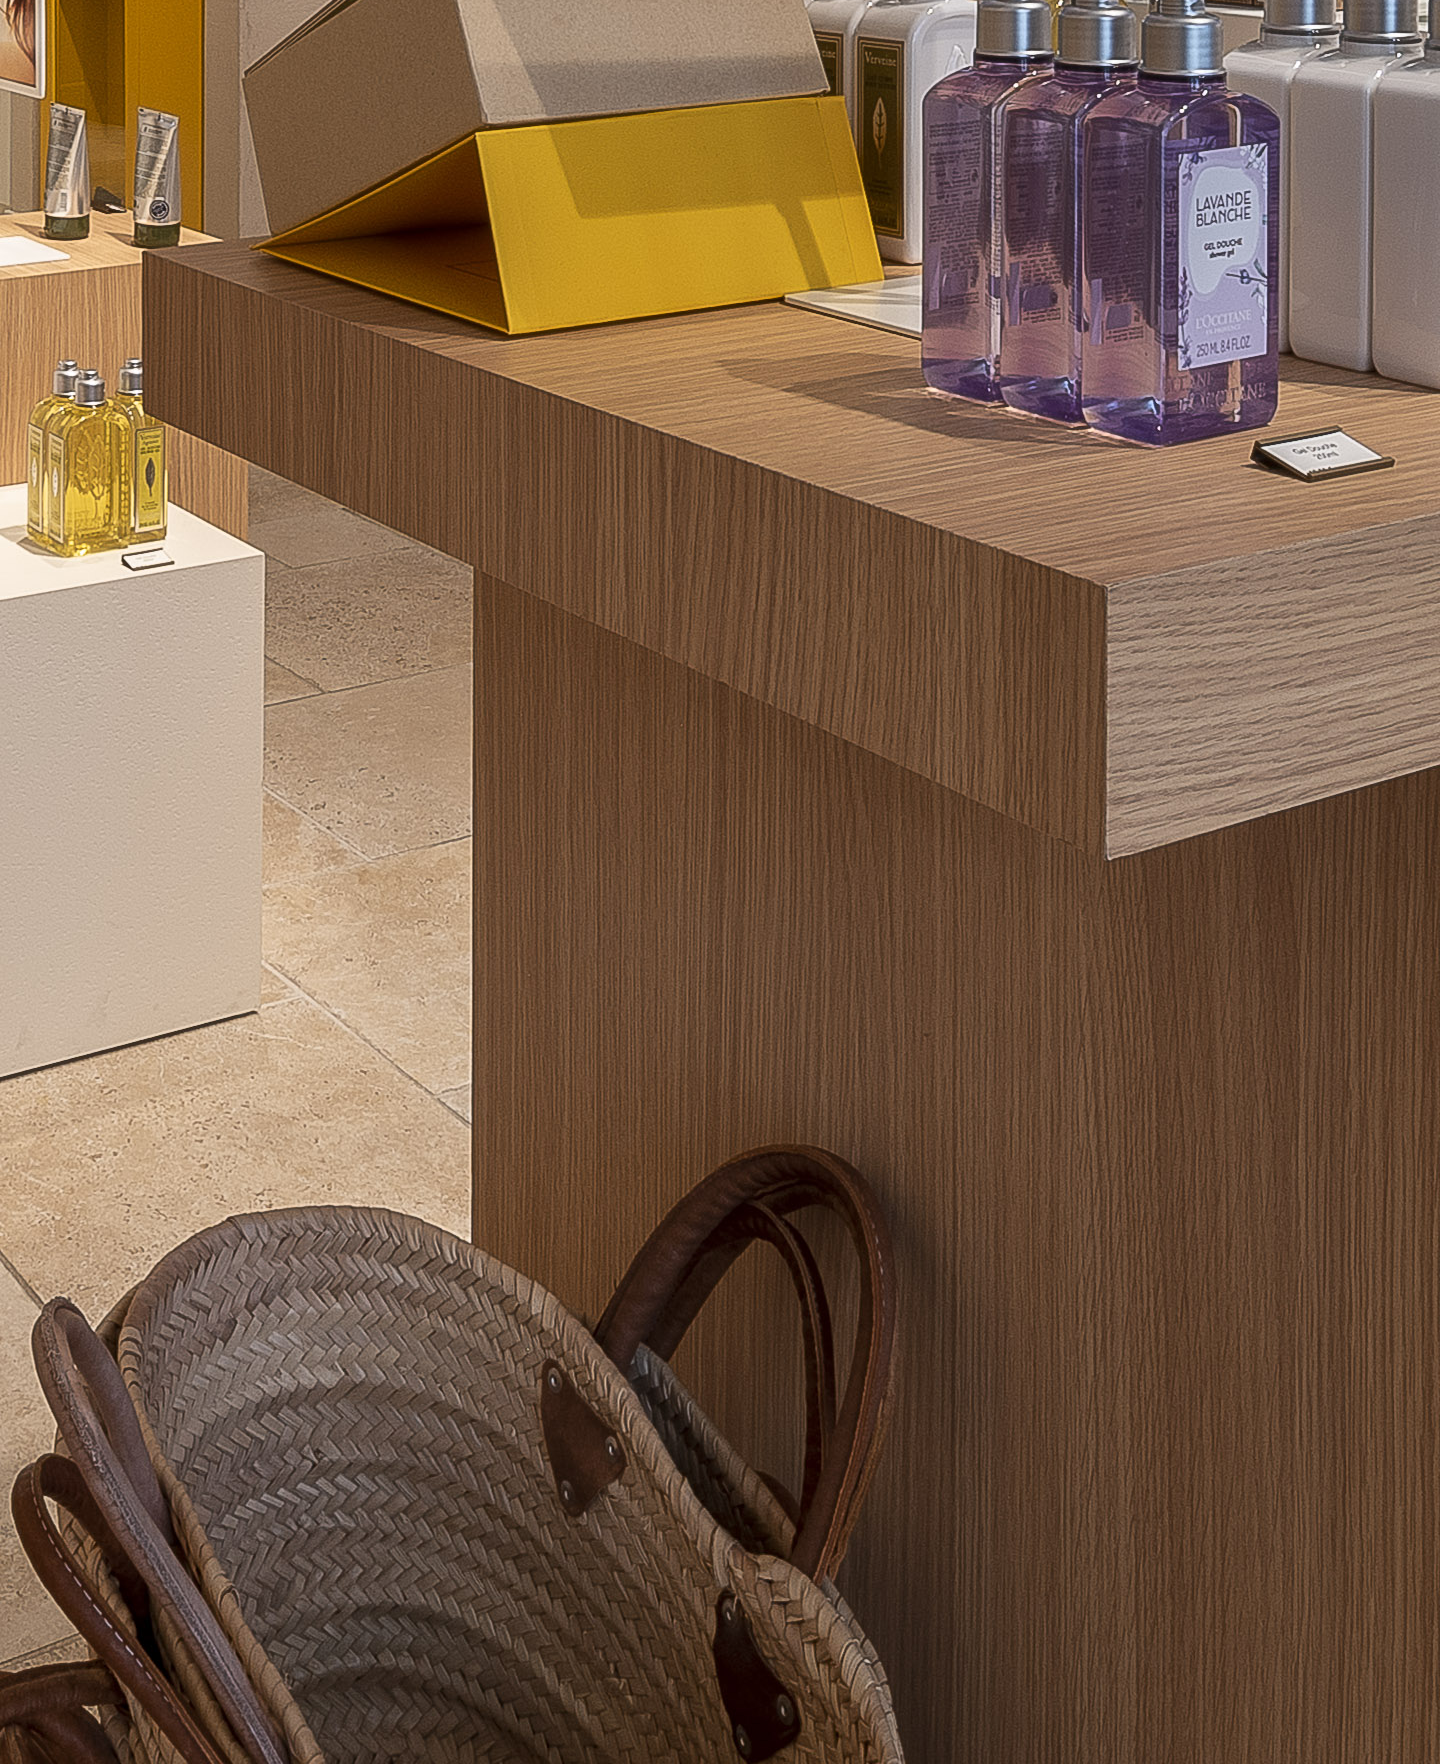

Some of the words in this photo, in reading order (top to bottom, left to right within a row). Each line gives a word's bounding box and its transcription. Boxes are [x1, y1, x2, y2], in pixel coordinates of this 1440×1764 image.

[864, 50, 897, 67] Verveine
[1195, 190, 1252, 212] LAVANDE
[1195, 207, 1252, 228] BLANCHE
[1203, 241, 1216, 252] GEL
[1216, 237, 1244, 250] DOUCHE
[1209, 249, 1227, 260] shower
[1227, 248, 1235, 259] gel
[1195, 308, 1252, 330] L'OCCITANE
[1196, 343, 1209, 358] 250
[1209, 341, 1219, 356] ML
